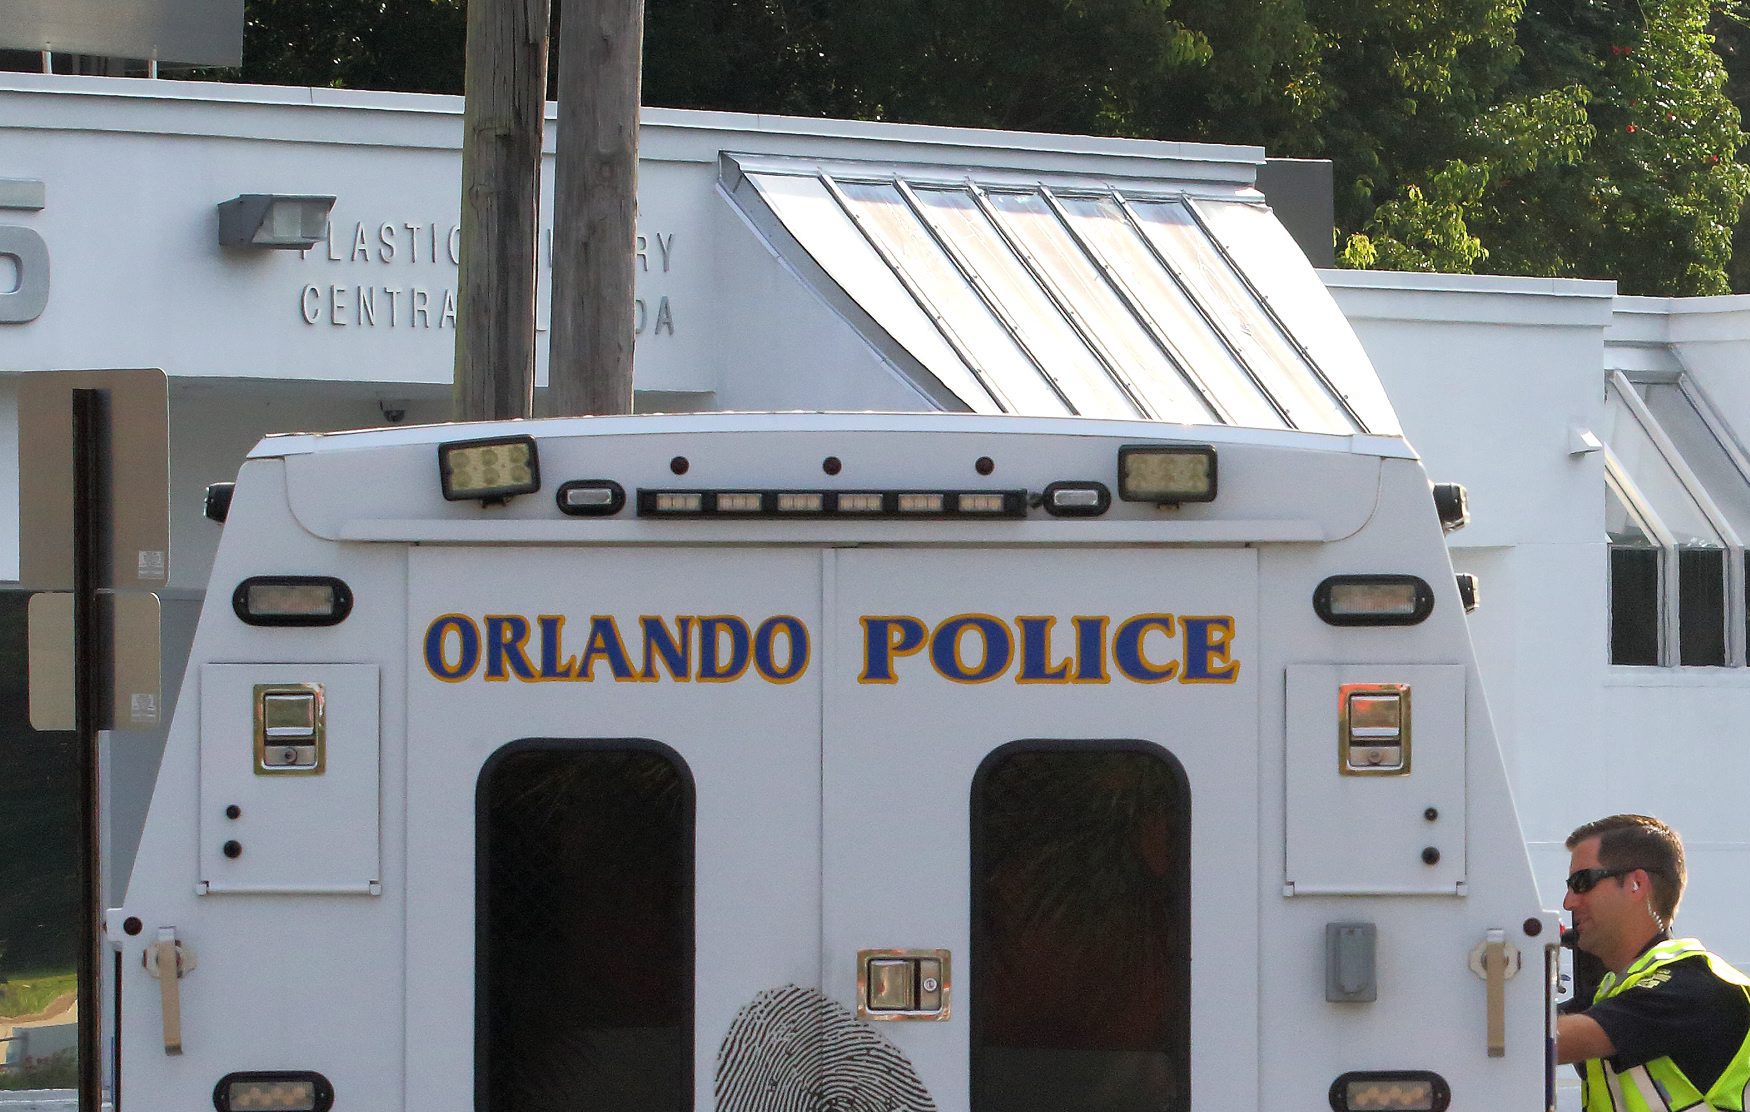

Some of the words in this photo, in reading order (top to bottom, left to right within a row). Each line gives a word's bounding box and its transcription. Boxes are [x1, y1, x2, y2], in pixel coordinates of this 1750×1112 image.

[301, 221, 460, 264] LASTIC
[301, 283, 457, 329] CENTRA
[423, 613, 811, 684] ORLANDO
[857, 612, 1240, 685] POLICE
